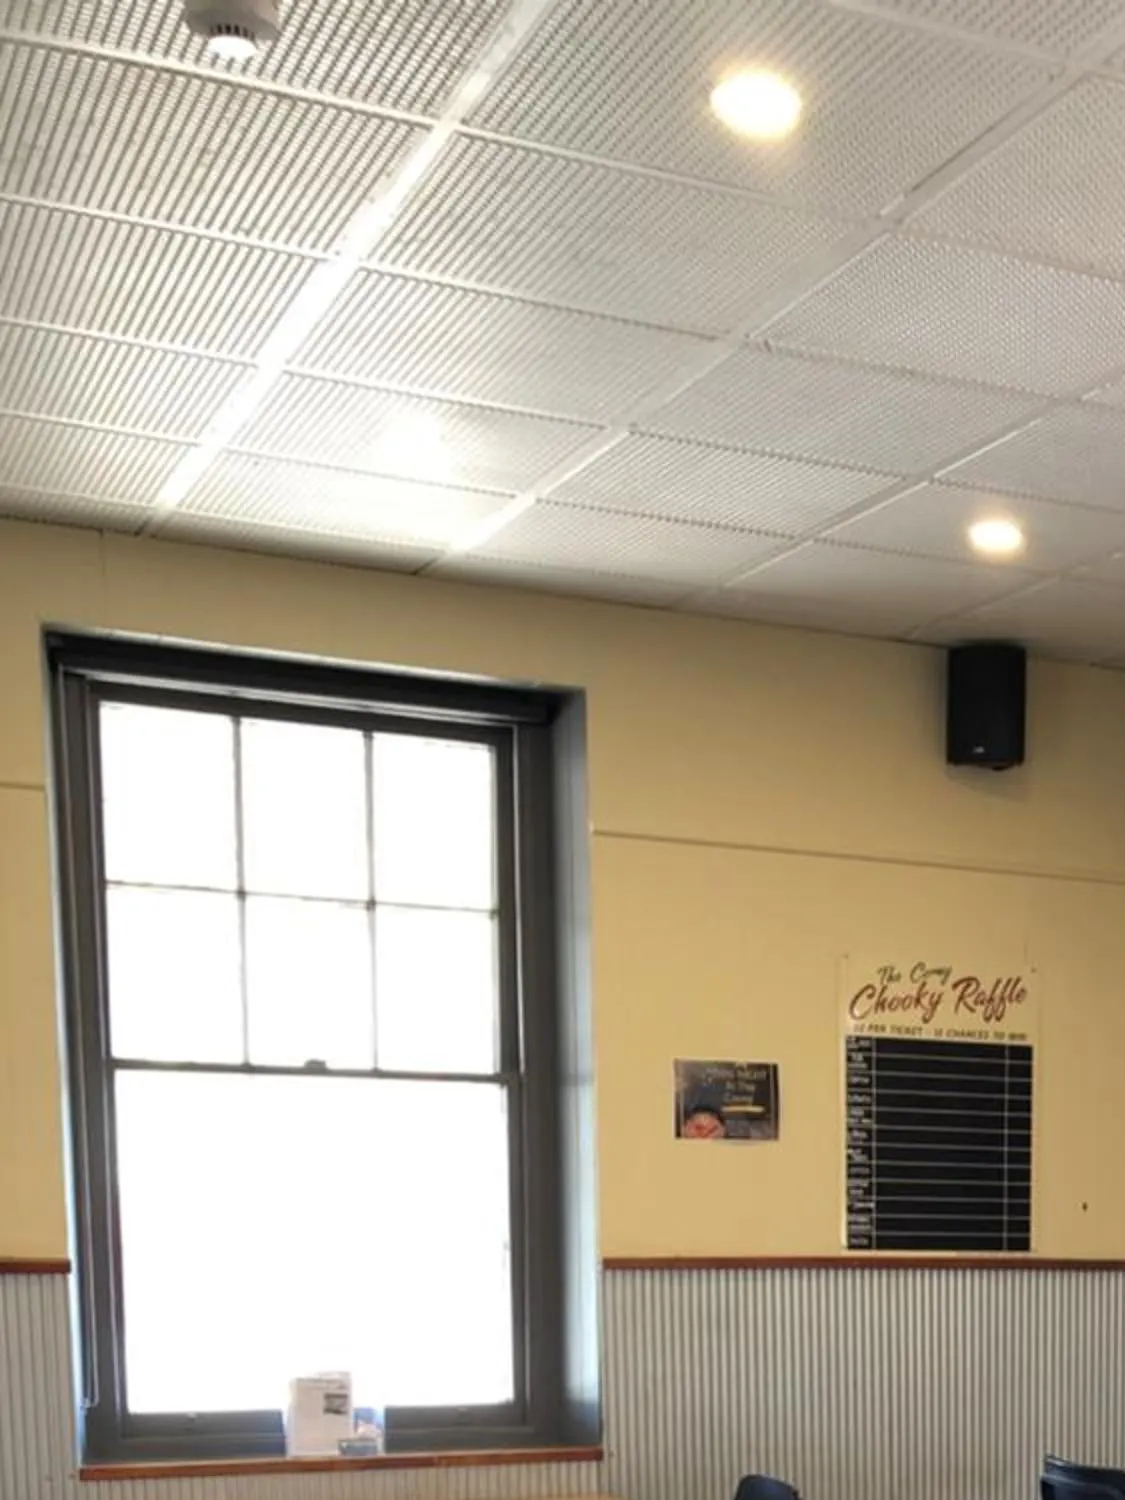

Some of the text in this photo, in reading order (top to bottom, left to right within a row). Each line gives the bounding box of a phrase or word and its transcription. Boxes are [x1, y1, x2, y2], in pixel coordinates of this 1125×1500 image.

[877, 964, 901, 984] The
[849, 975, 1028, 1024] Chooky Raffle
